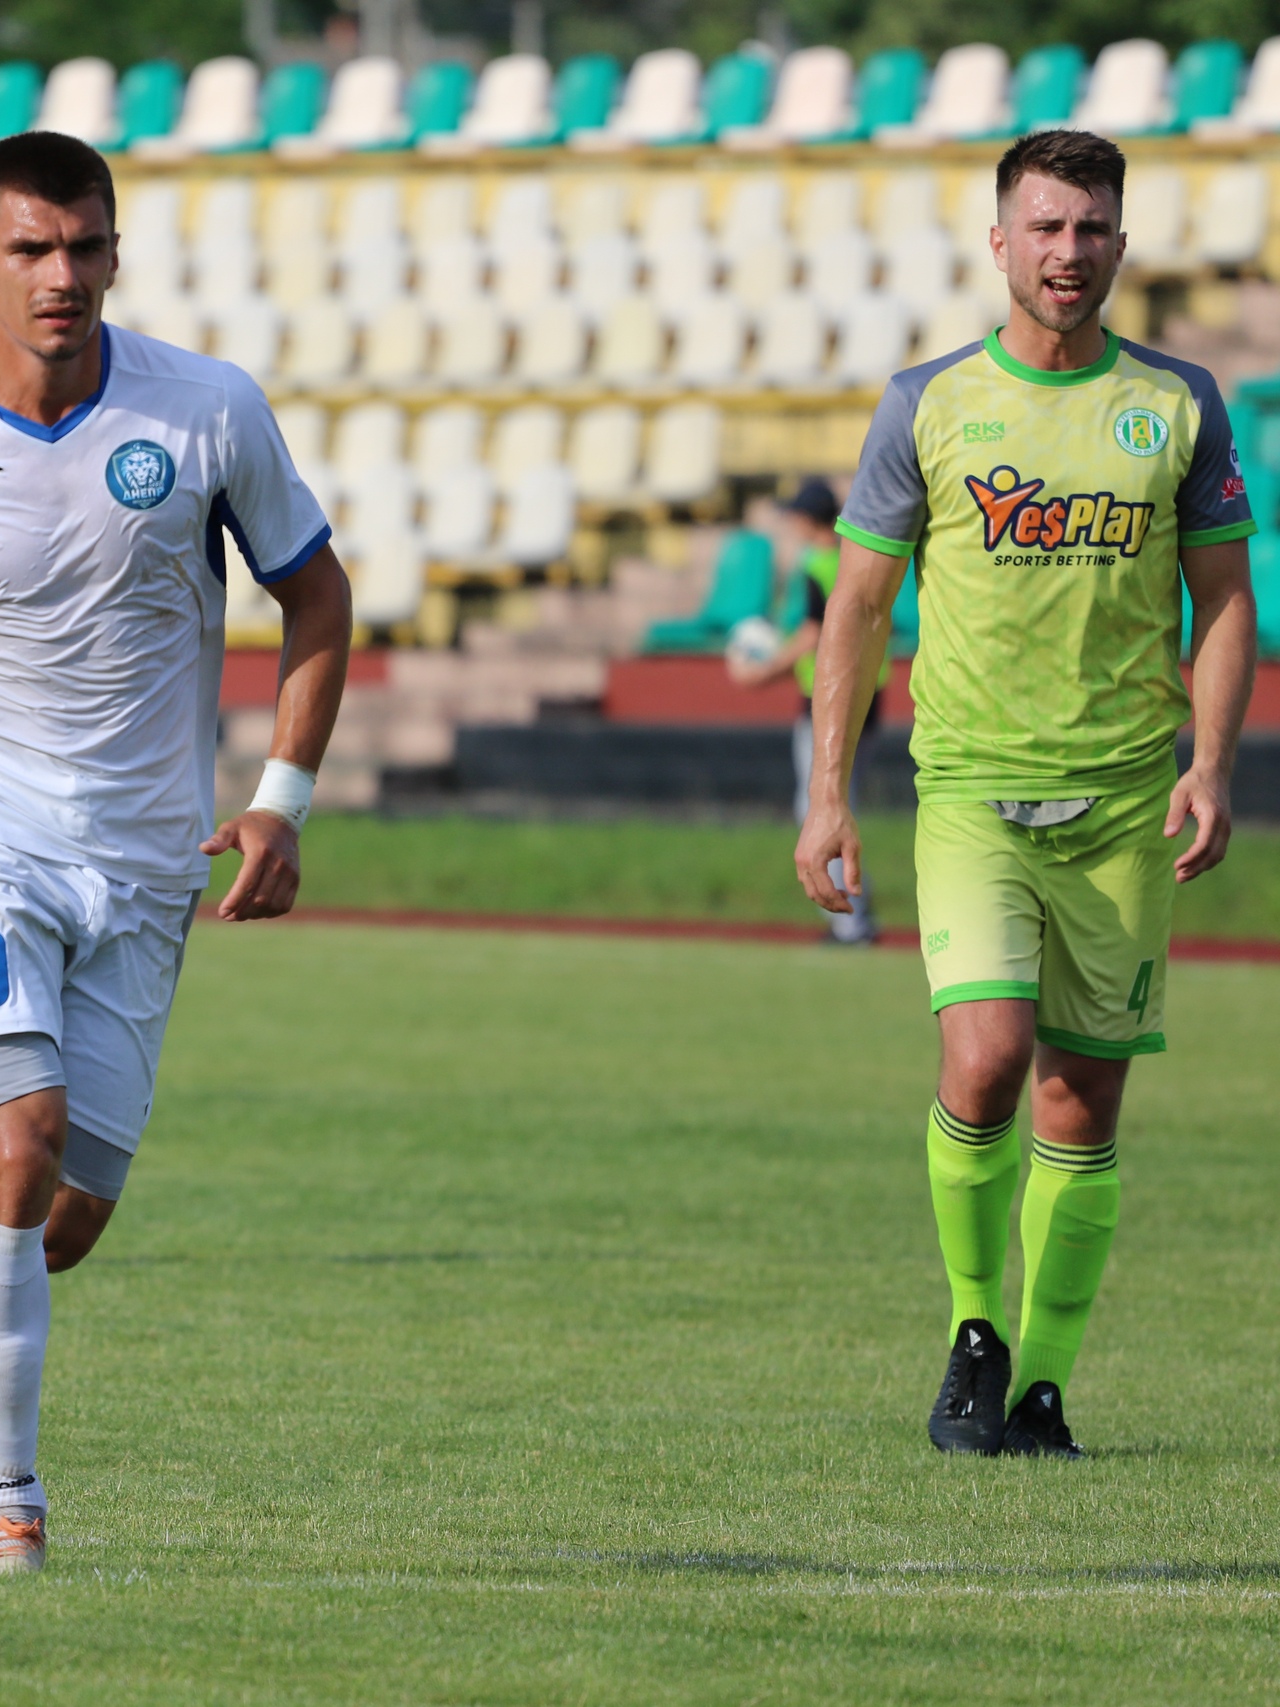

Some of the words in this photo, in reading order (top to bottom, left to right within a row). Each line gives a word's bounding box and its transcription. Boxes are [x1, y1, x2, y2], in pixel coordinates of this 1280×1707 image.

[122, 487, 164, 501] ДНЕПР
[994, 555, 1052, 567] SPORTS
[1056, 554, 1116, 567] BETTING
[1127, 958, 1155, 1026] 4
